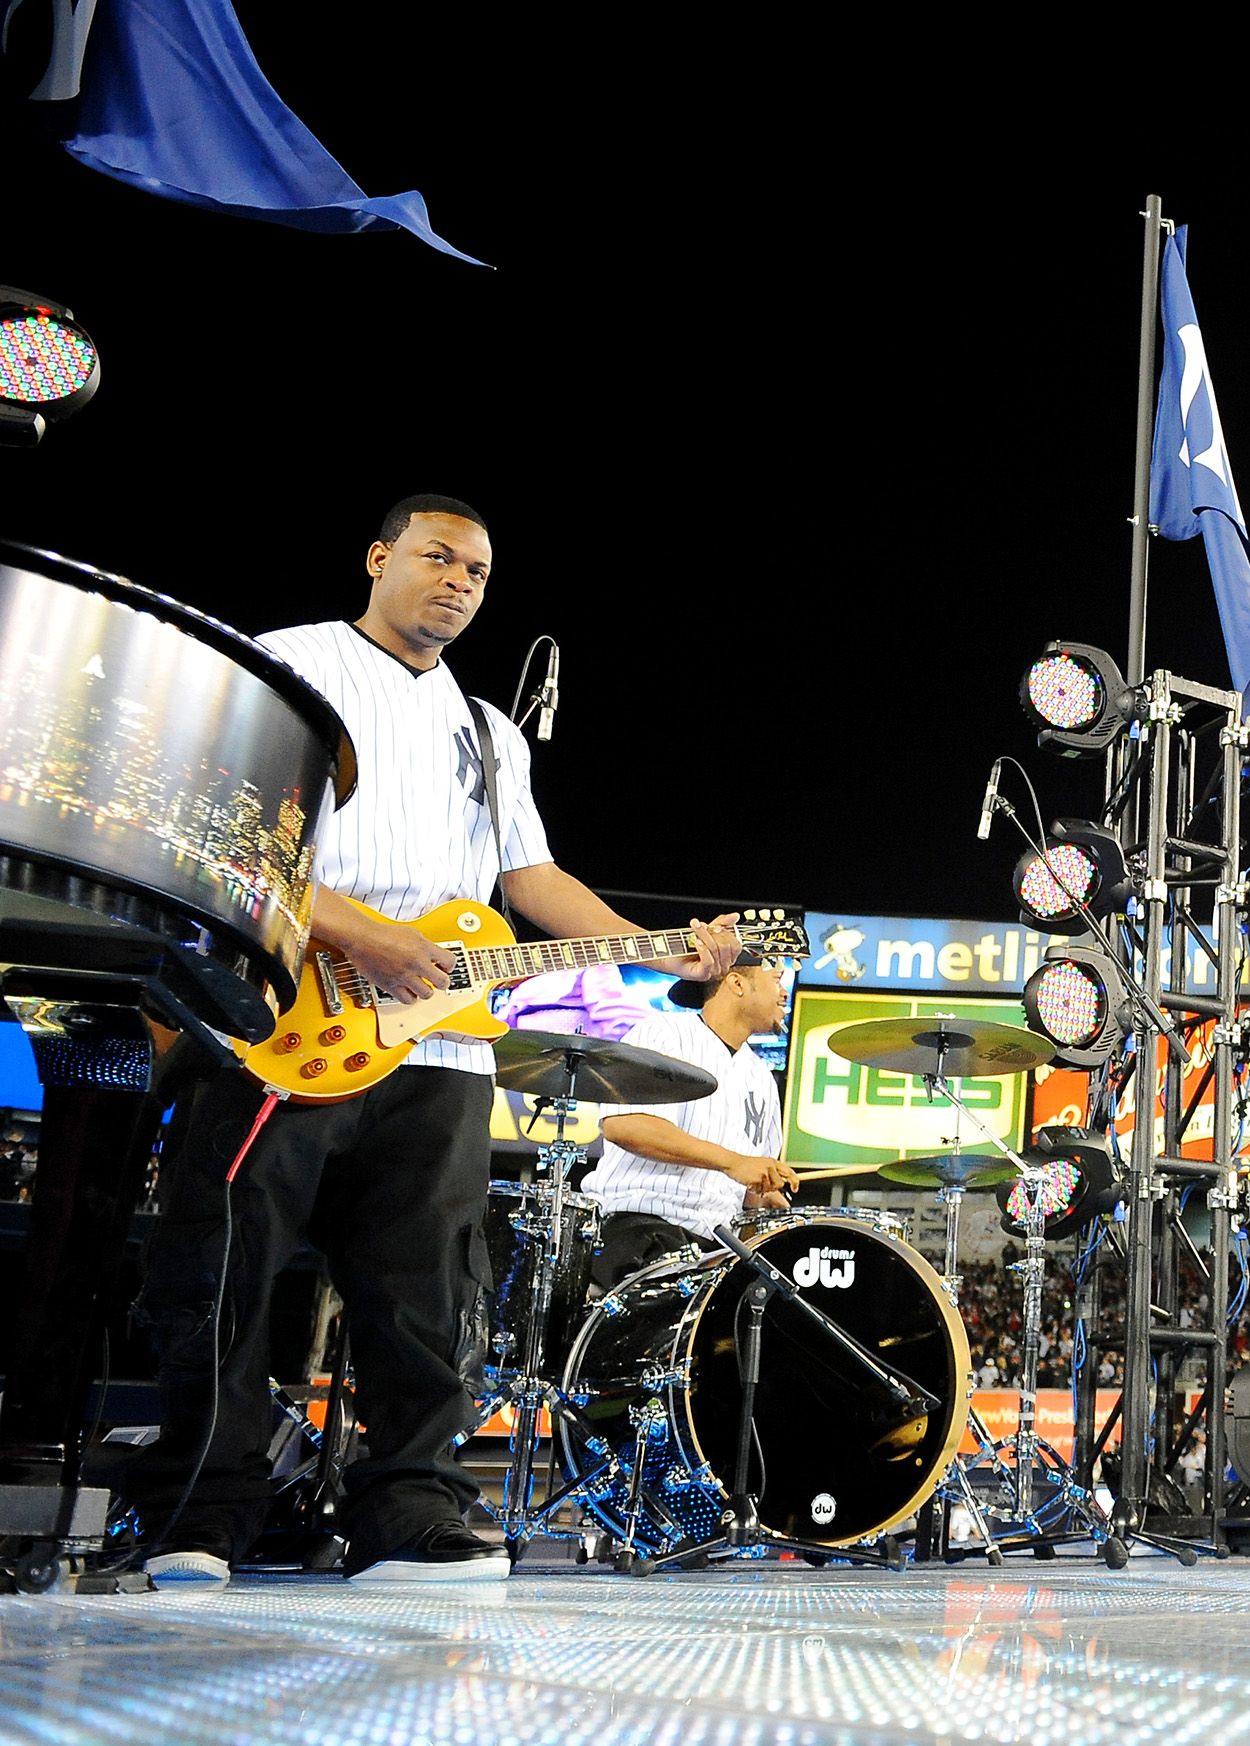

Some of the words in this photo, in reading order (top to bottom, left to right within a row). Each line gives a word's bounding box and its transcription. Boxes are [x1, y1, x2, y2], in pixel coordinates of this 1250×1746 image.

[812, 1056, 1003, 1108] HESS
[820, 1246, 855, 1259] drums
[793, 1247, 855, 1289] dw
[814, 1502, 832, 1515] dw
